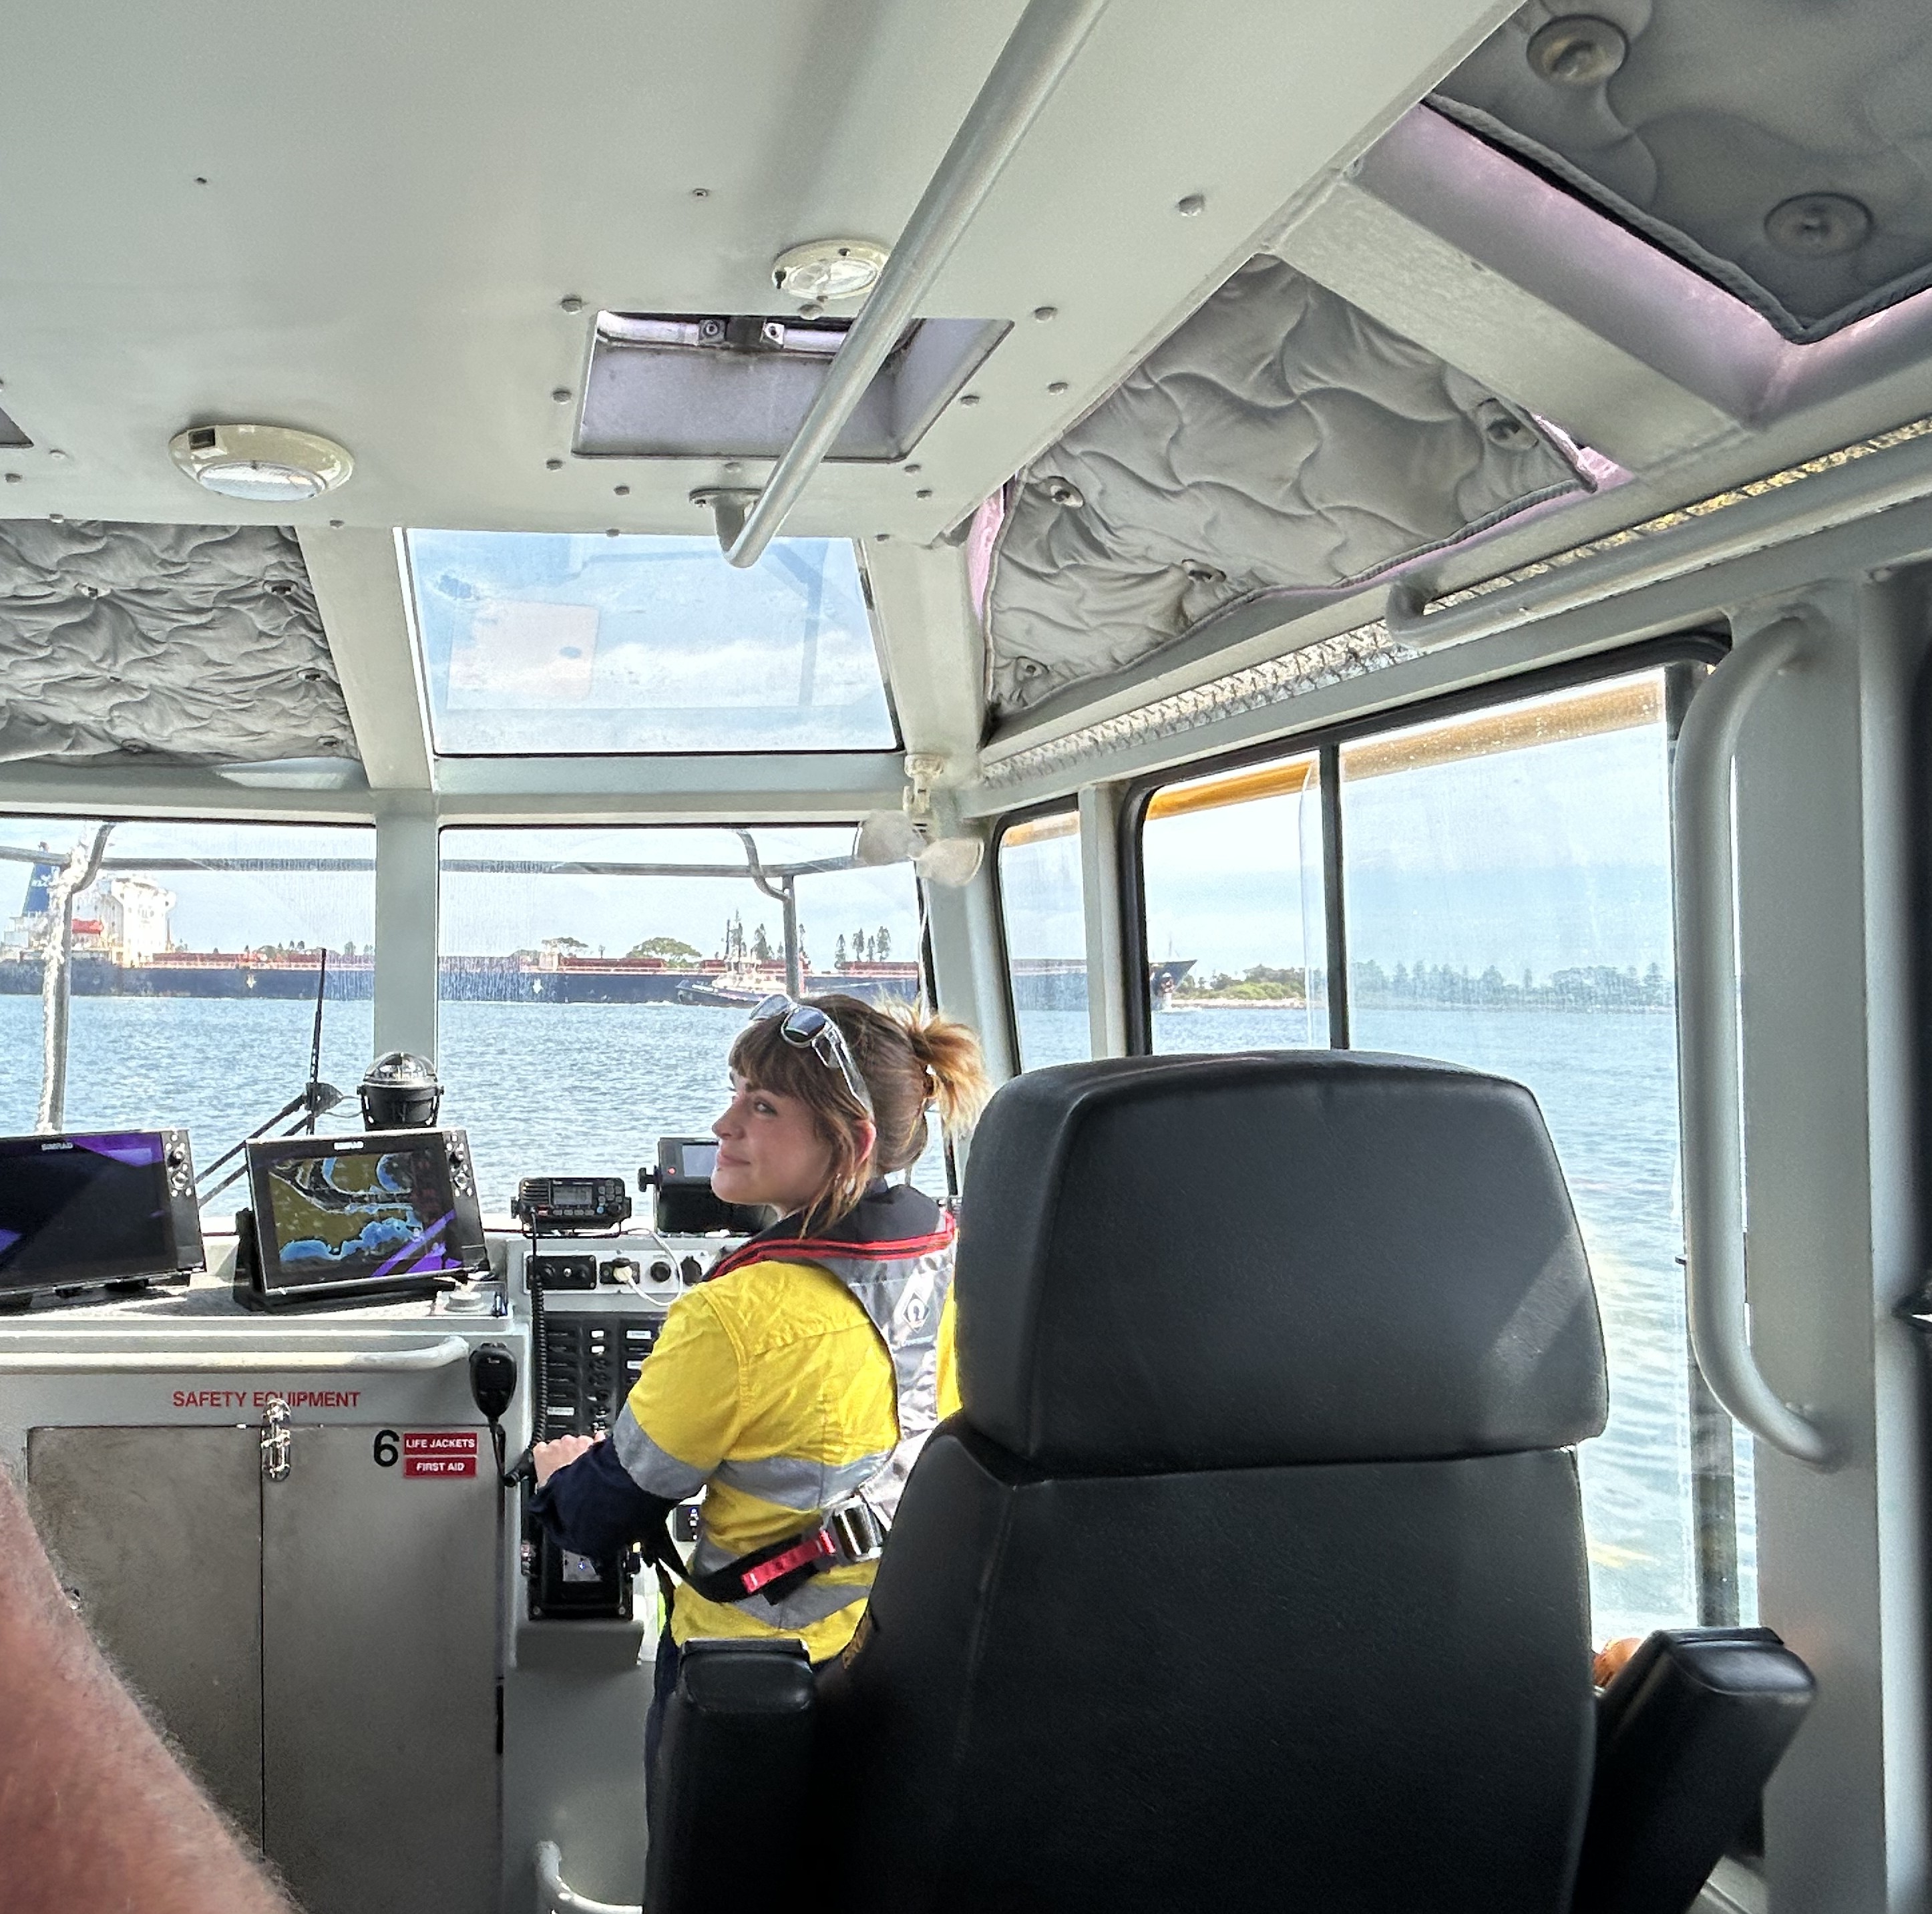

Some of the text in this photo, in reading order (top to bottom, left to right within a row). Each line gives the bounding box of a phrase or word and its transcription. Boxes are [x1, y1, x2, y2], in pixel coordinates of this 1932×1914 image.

[172, 1391, 247, 1407] SAFETY
[373, 1429, 400, 1467] 6
[406, 1439, 475, 1448] LIFE JACKETS
[416, 1463, 465, 1472] FIRST AID
